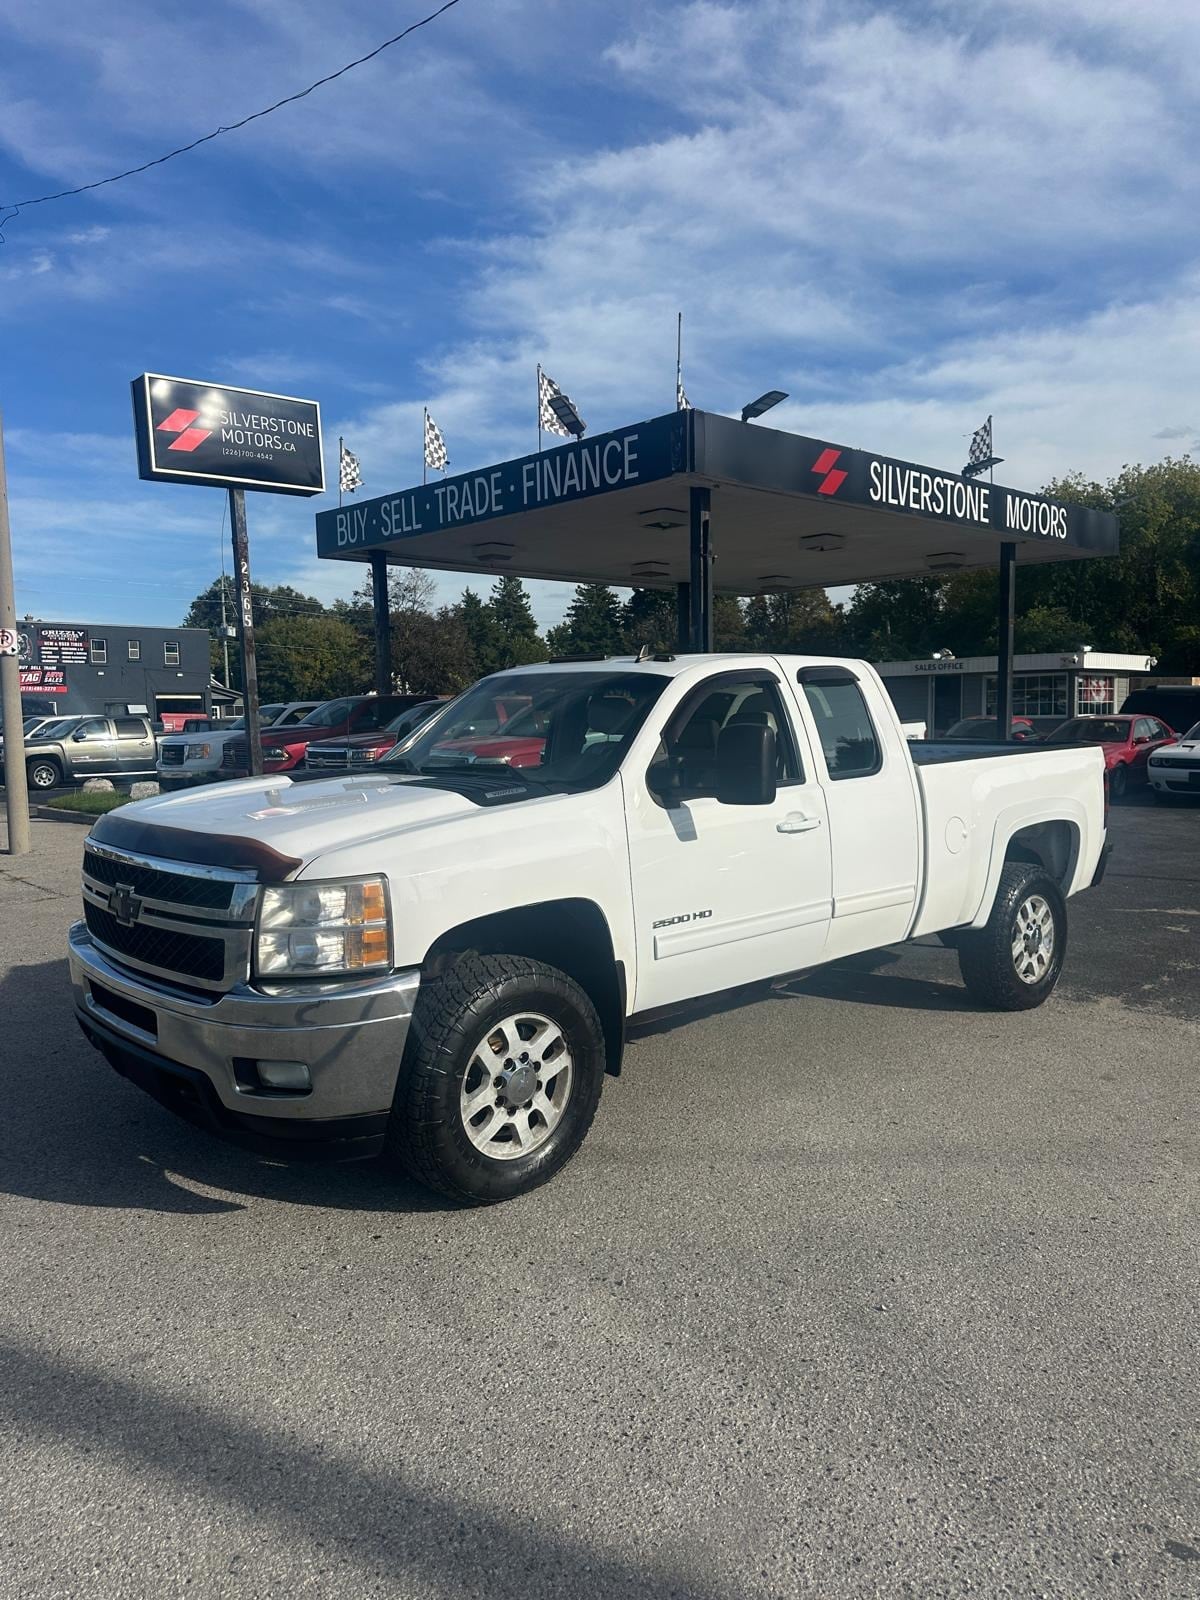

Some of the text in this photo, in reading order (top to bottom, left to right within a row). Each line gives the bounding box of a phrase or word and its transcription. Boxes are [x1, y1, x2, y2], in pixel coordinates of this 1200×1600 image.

[219, 410, 315, 438] SILVERSTONE
[221, 429, 297, 452] MOTORS.CA
[222, 447, 273, 460] (226)700-4542
[336, 434, 639, 546] BUY SELL TRADE FINANCE
[869, 461, 1067, 539] SILVERSTONE MOTORS
[241, 561, 252, 627] 2365
[21, 673, 40, 683] TAG
[914, 662, 964, 671] SALES OFFICE
[652, 909, 713, 929] 2500 HD
